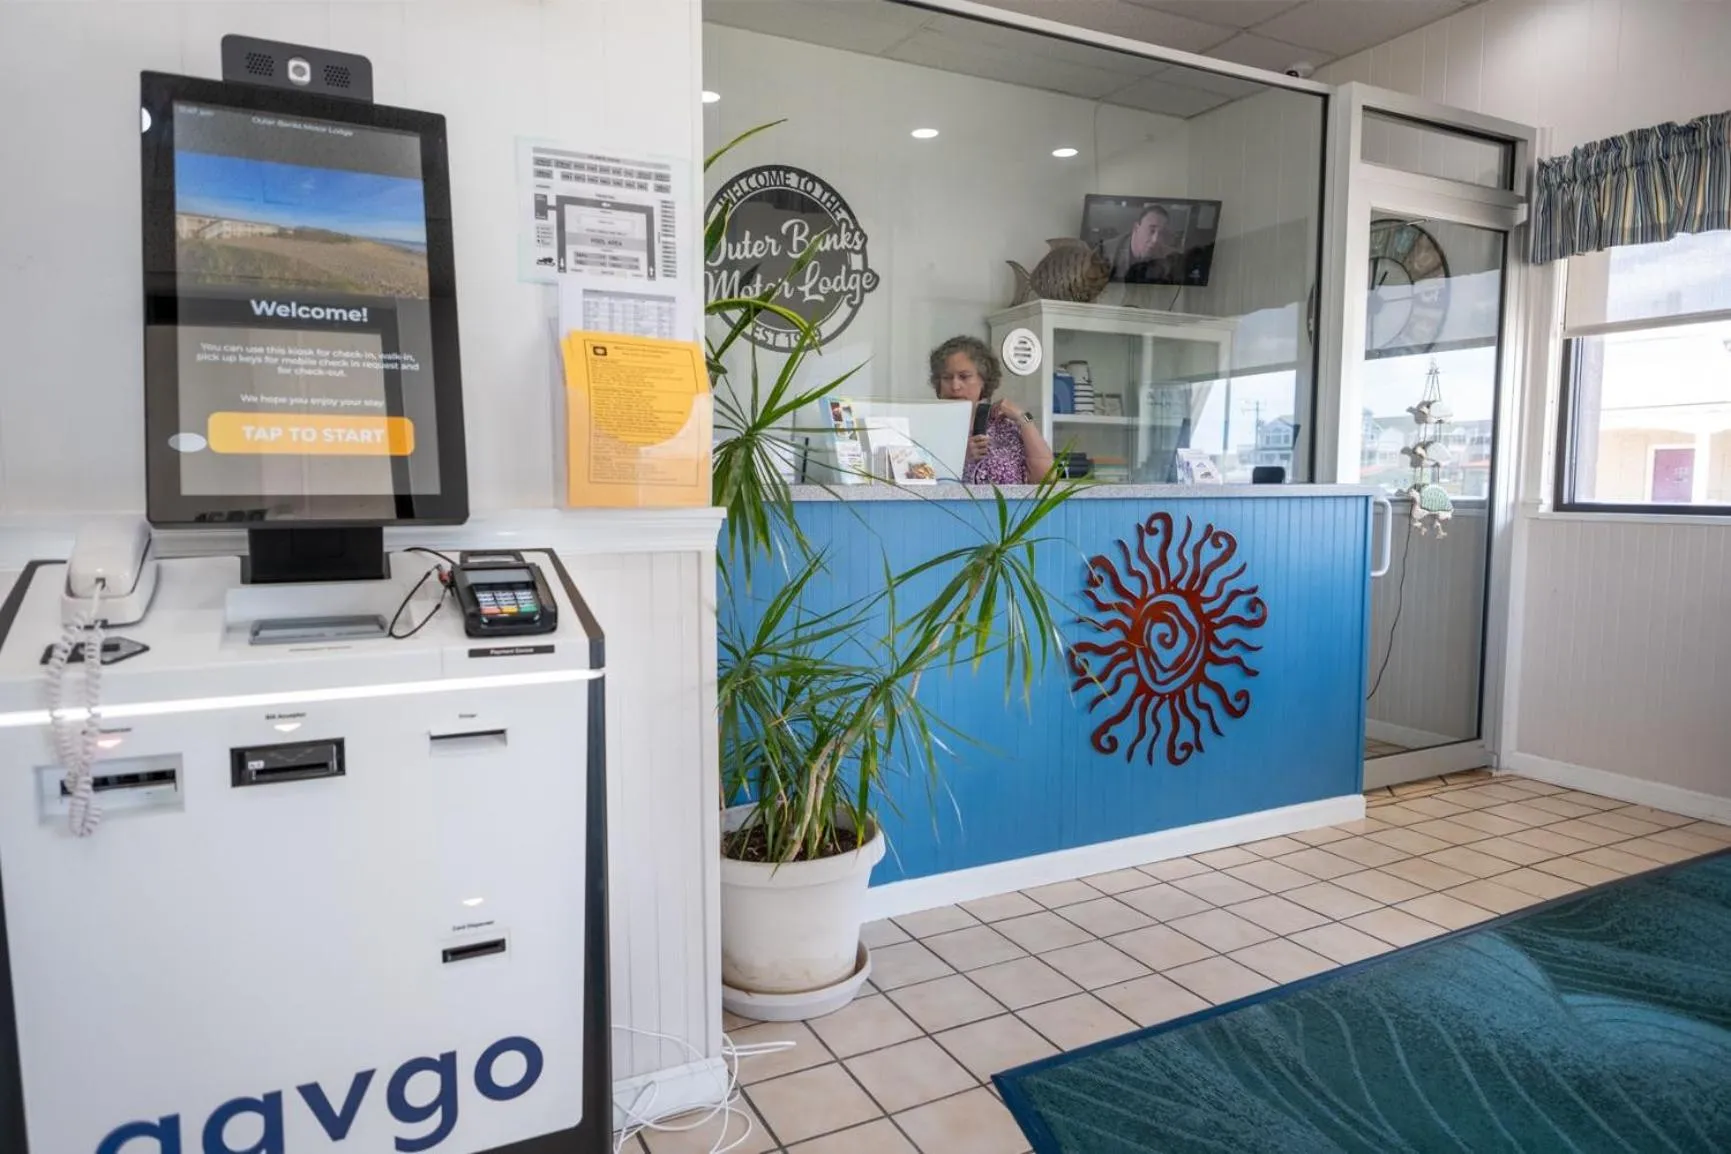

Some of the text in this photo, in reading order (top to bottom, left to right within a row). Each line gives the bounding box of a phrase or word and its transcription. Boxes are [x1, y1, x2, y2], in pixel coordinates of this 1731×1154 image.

[718, 170, 847, 221] WELCOME TO THE
[798, 260, 877, 305] Lodge
[250, 299, 369, 323] Welcome!
[200, 342, 222, 352] You
[223, 345, 243, 353] can
[245, 346, 264, 354] use
[266, 346, 286, 355] this
[287, 346, 314, 356] kiosk
[316, 348, 330, 357] for
[196, 353, 420, 371] pick up keys for mobile check in request and
[277, 365, 291, 374] for
[240, 393, 258, 403] We
[260, 393, 287, 405] hope
[288, 396, 308, 406] you
[310, 397, 338, 407] enjoy
[339, 398, 362, 407] your
[242, 425, 385, 443] TAP TO START
